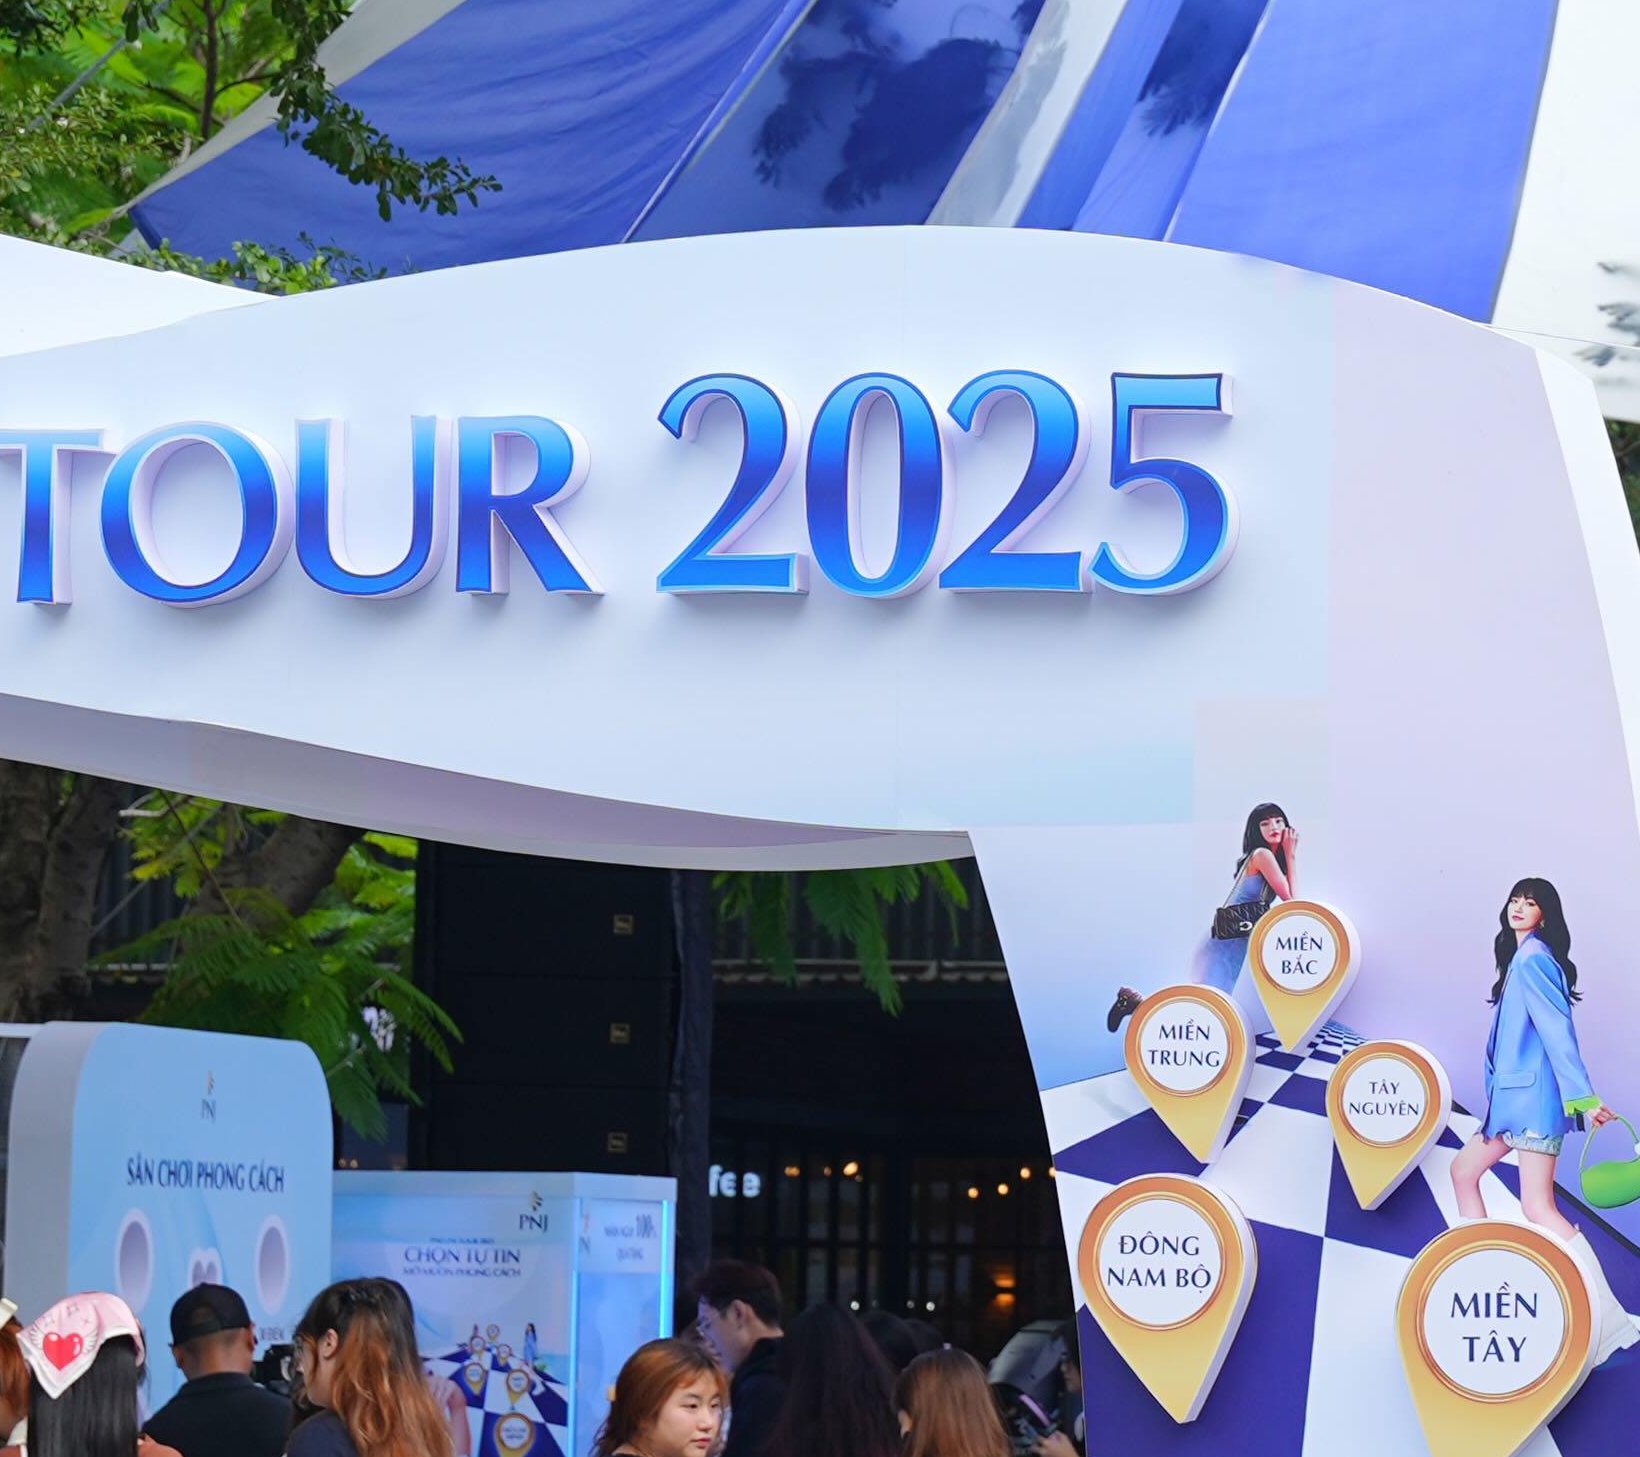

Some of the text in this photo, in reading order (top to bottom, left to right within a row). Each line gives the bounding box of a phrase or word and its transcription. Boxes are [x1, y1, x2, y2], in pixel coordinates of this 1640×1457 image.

[656, 368, 1234, 599] 2025
[1274, 929, 1324, 953] MIỀN
[1280, 954, 1319, 978] BẮC
[1157, 1019, 1212, 1043] MIỀN
[1146, 1046, 1222, 1070] TRUNG
[1368, 1078, 1400, 1096] TÂY
[1347, 1097, 1421, 1119] NGUYÊN
[196, 1160, 245, 1191] PHONG
[248, 1160, 286, 1193] CÁCH
[708, 1164, 761, 1198] fee
[519, 1213, 548, 1233] PNJ
[404, 1246, 461, 1266] CHỌN
[493, 1248, 521, 1264] TIN
[1118, 1232, 1201, 1259] ĐÔNG
[1106, 1265, 1213, 1294] NAM BỘ
[1449, 1279, 1540, 1321] MIỀN
[1462, 1331, 1529, 1365] TÂY
